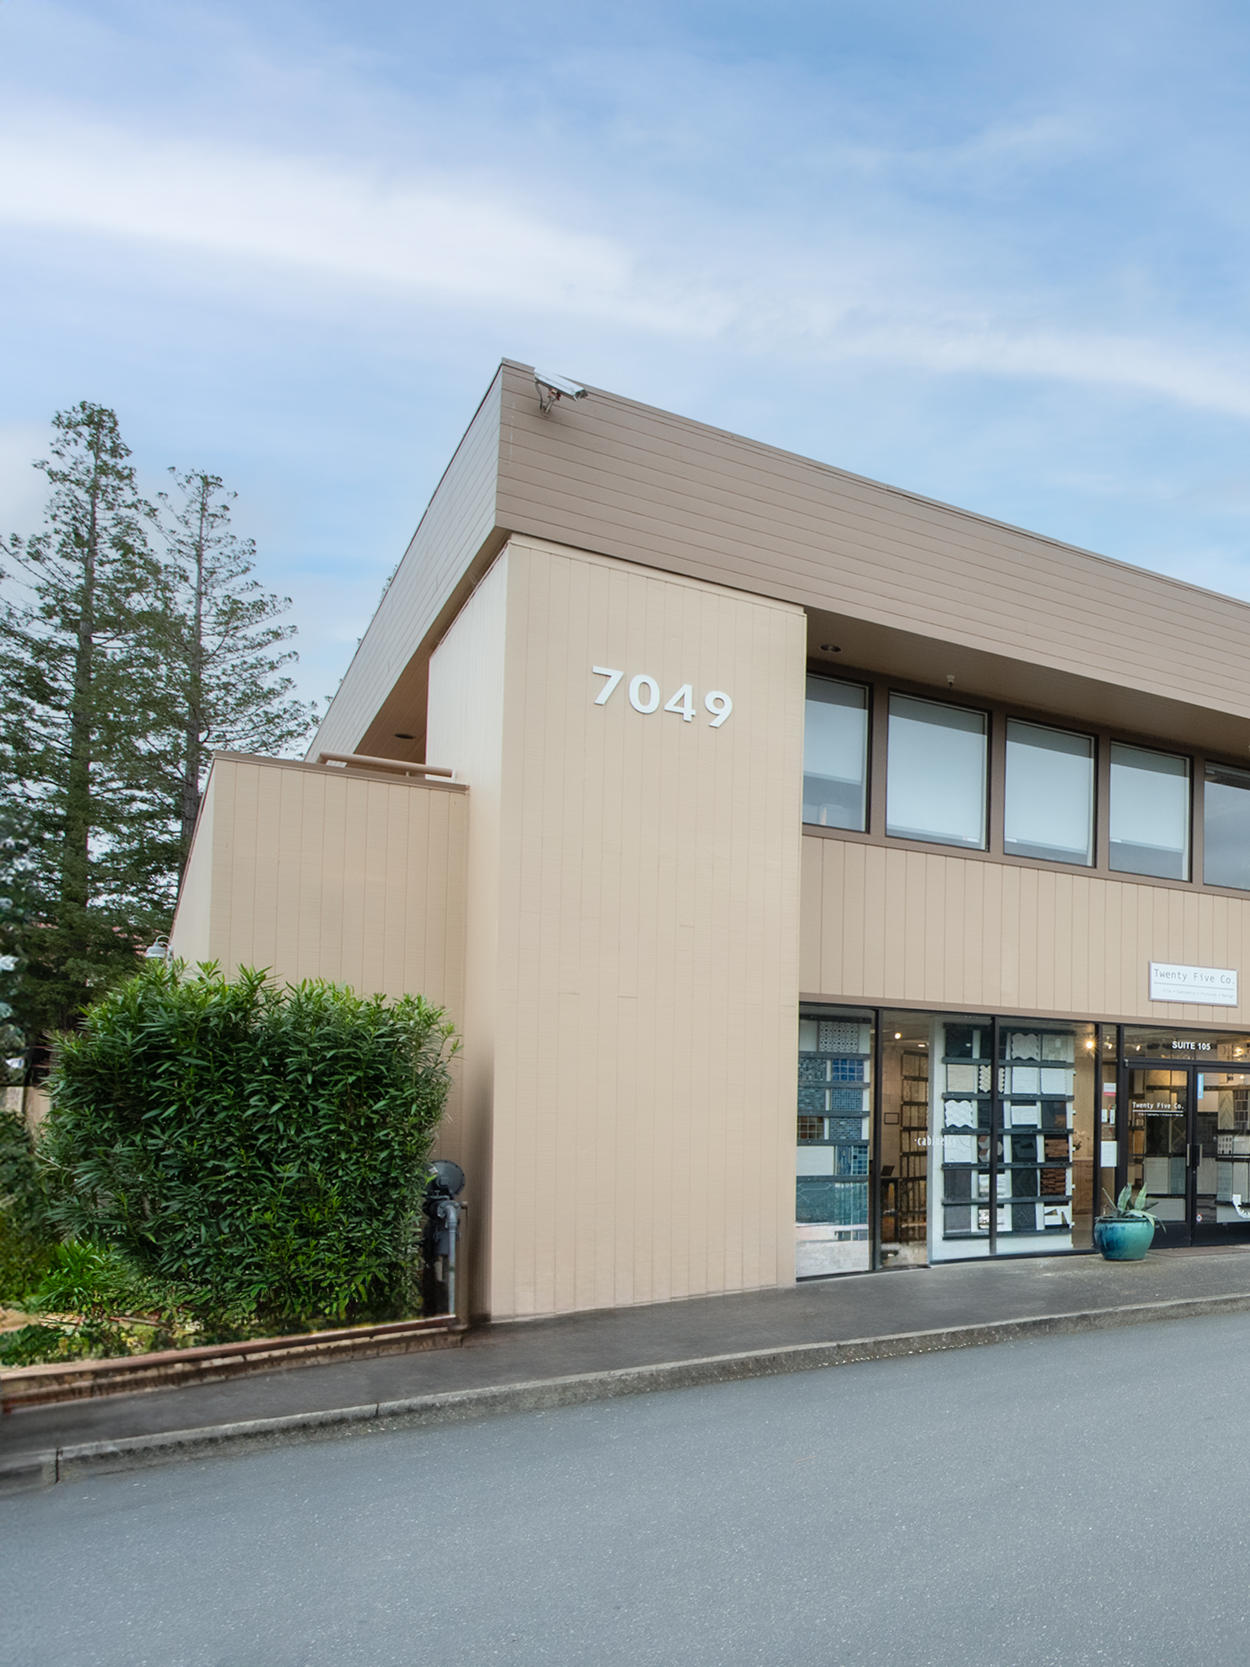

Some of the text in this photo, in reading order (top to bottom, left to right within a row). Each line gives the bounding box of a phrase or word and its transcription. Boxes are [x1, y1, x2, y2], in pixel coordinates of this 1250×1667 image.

[592, 665, 733, 728] 7049
[1154, 968, 1235, 985] Twenty Five Co.
[1171, 1040, 1211, 1051] SUITE 105
[1132, 1101, 1154, 1110] Twenty
[1173, 1102, 1184, 1110] Co.
